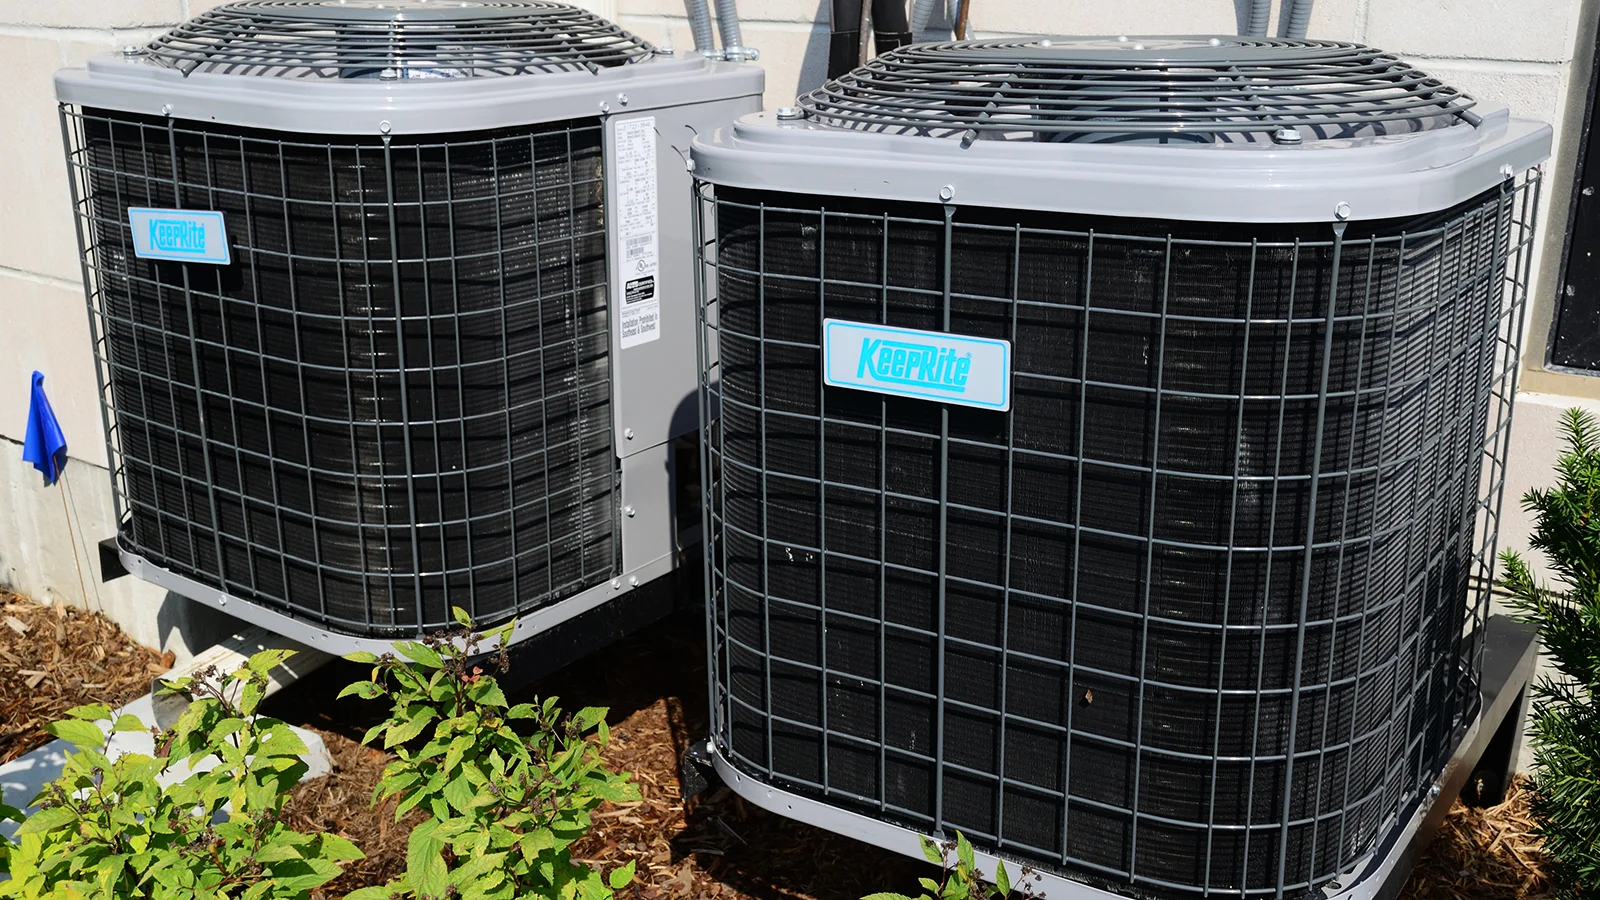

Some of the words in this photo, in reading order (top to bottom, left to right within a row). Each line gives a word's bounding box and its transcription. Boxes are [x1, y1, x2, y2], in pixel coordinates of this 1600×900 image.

[149, 218, 206, 254] KeepRite
[622, 318, 638, 329] Installation
[639, 314, 654, 324] Prohibited
[622, 327, 637, 338] Southeast
[641, 322, 655, 333] Southwest
[857, 337, 972, 393] KeepRite
